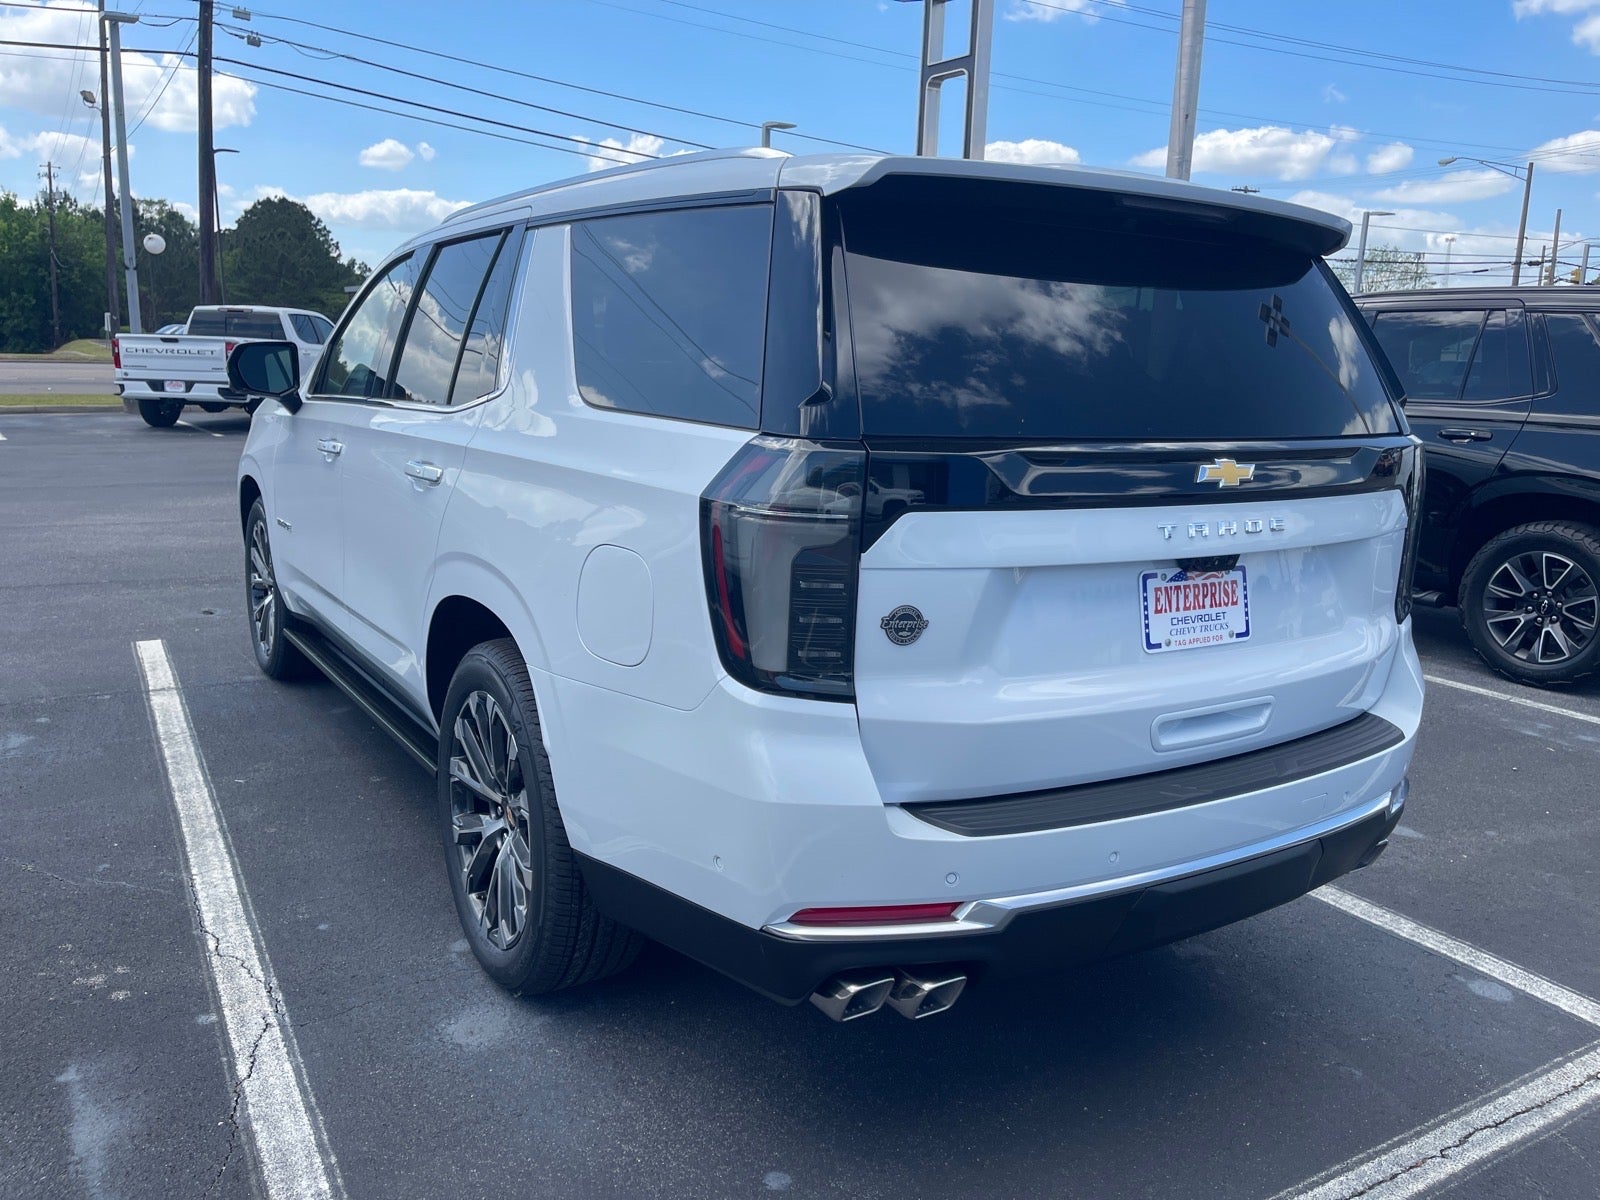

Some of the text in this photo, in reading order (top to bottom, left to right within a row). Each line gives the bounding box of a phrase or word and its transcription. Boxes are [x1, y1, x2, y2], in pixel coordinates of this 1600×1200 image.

[125, 347, 217, 356] CHEVROLET
[1157, 518, 1286, 540] TAHOE
[1154, 580, 1239, 614] ENTERPRISE
[1170, 612, 1227, 625] CHEVROLET
[1169, 622, 1230, 637] CHEVY TRUCKS
[1174, 634, 1224, 647] TAG APPLIED FOR
